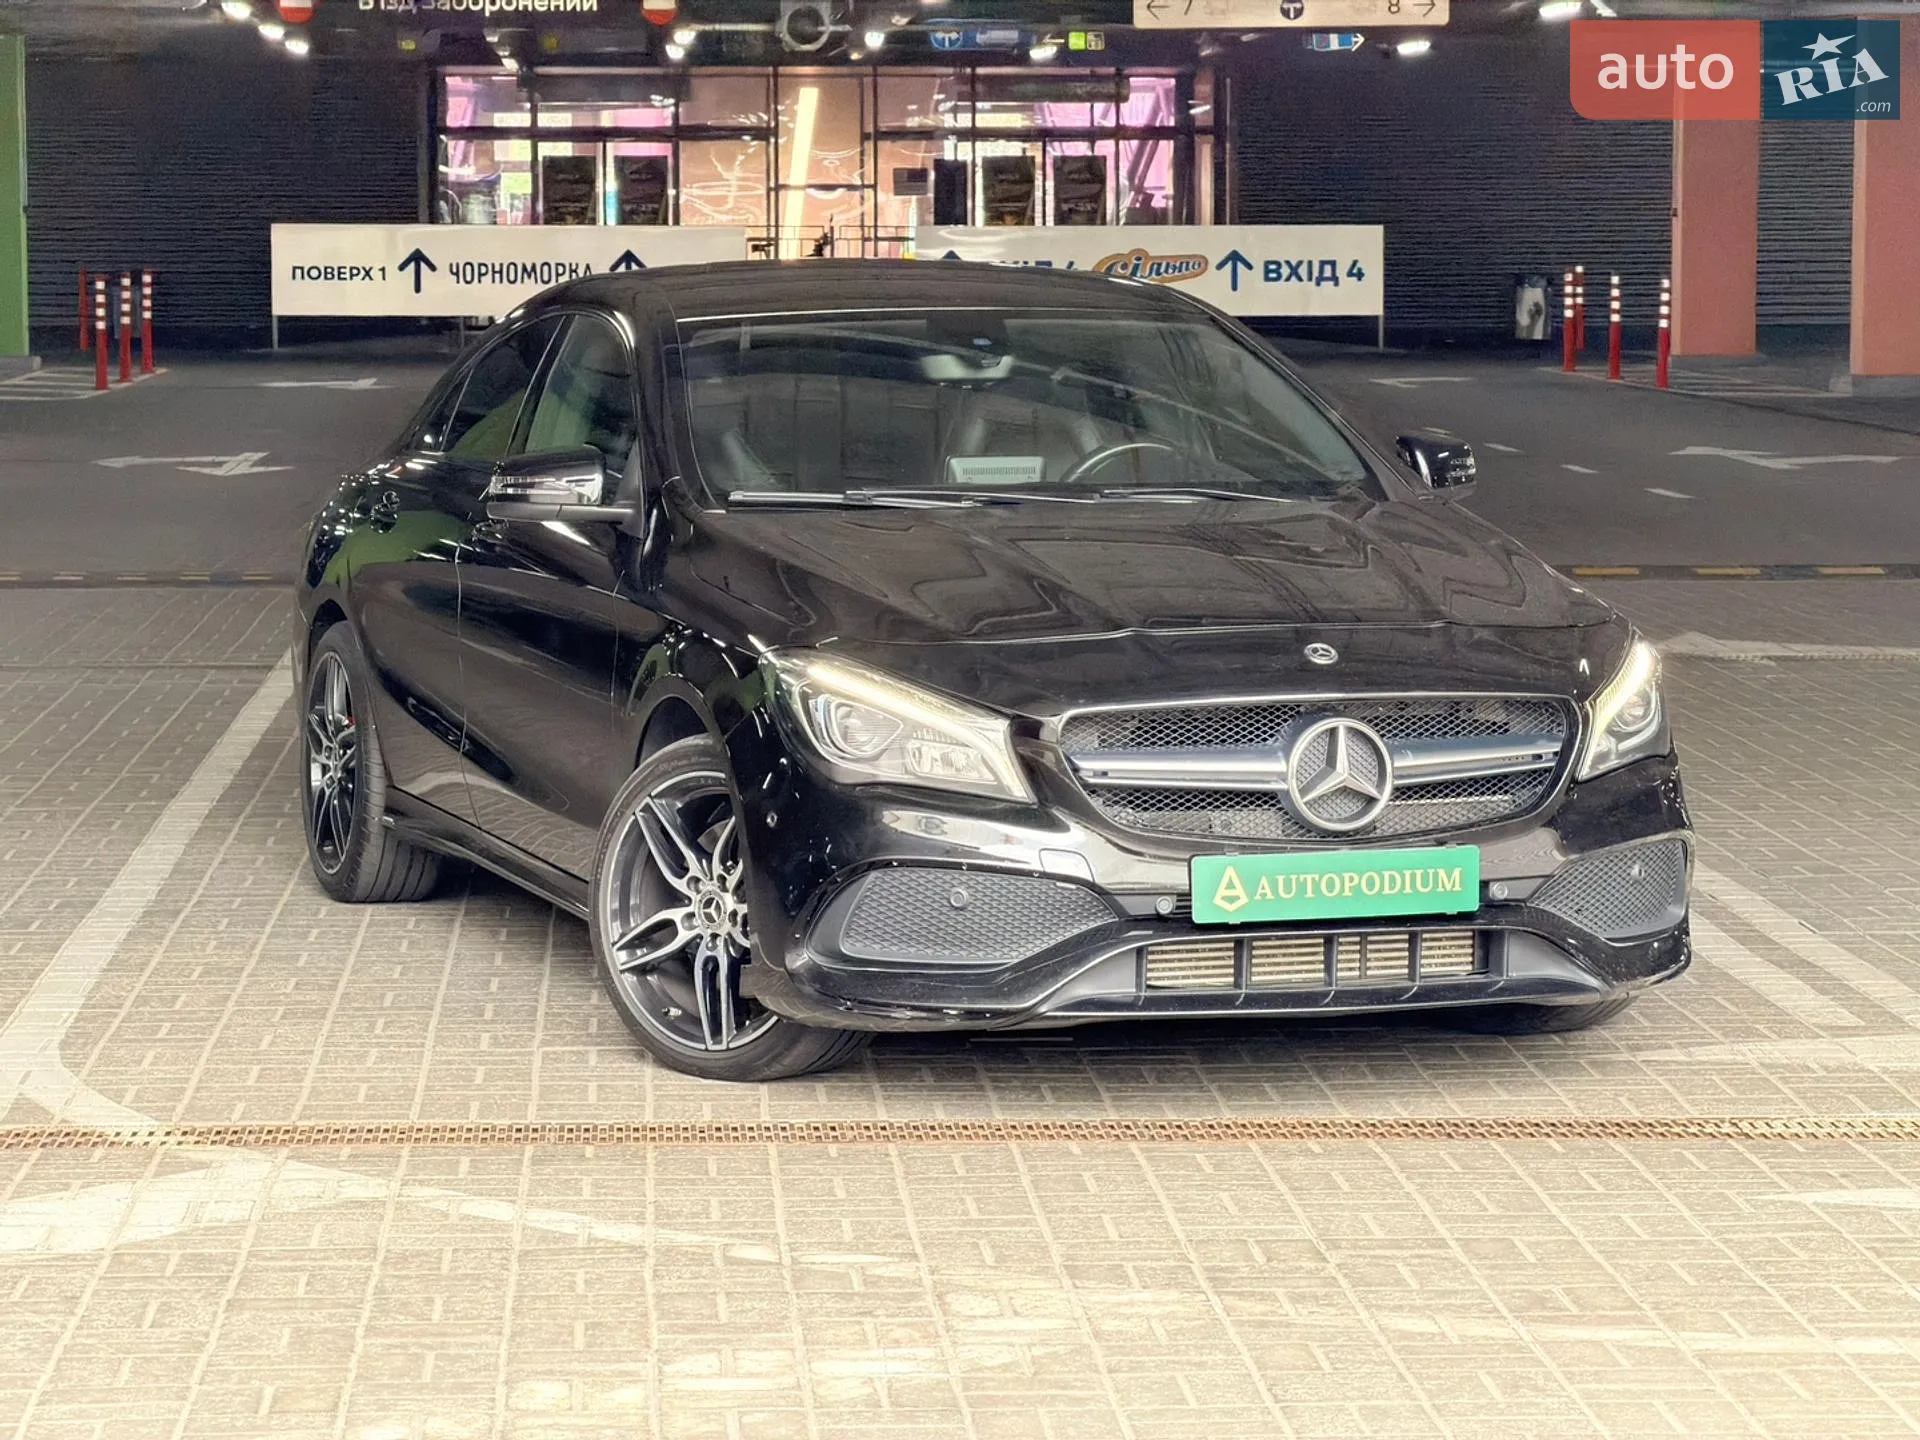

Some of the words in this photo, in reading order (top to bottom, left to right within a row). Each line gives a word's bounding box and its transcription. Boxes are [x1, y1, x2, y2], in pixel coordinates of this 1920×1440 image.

[291, 265, 374, 281] ПОВЕРХ
[378, 265, 387, 281] 1
[449, 261, 593, 285] ЧОРНОМОРКА
[1263, 259, 1340, 287] ВХІД
[1346, 259, 1365, 282] 4
[1254, 867, 1463, 901] AUTOPODIUM
